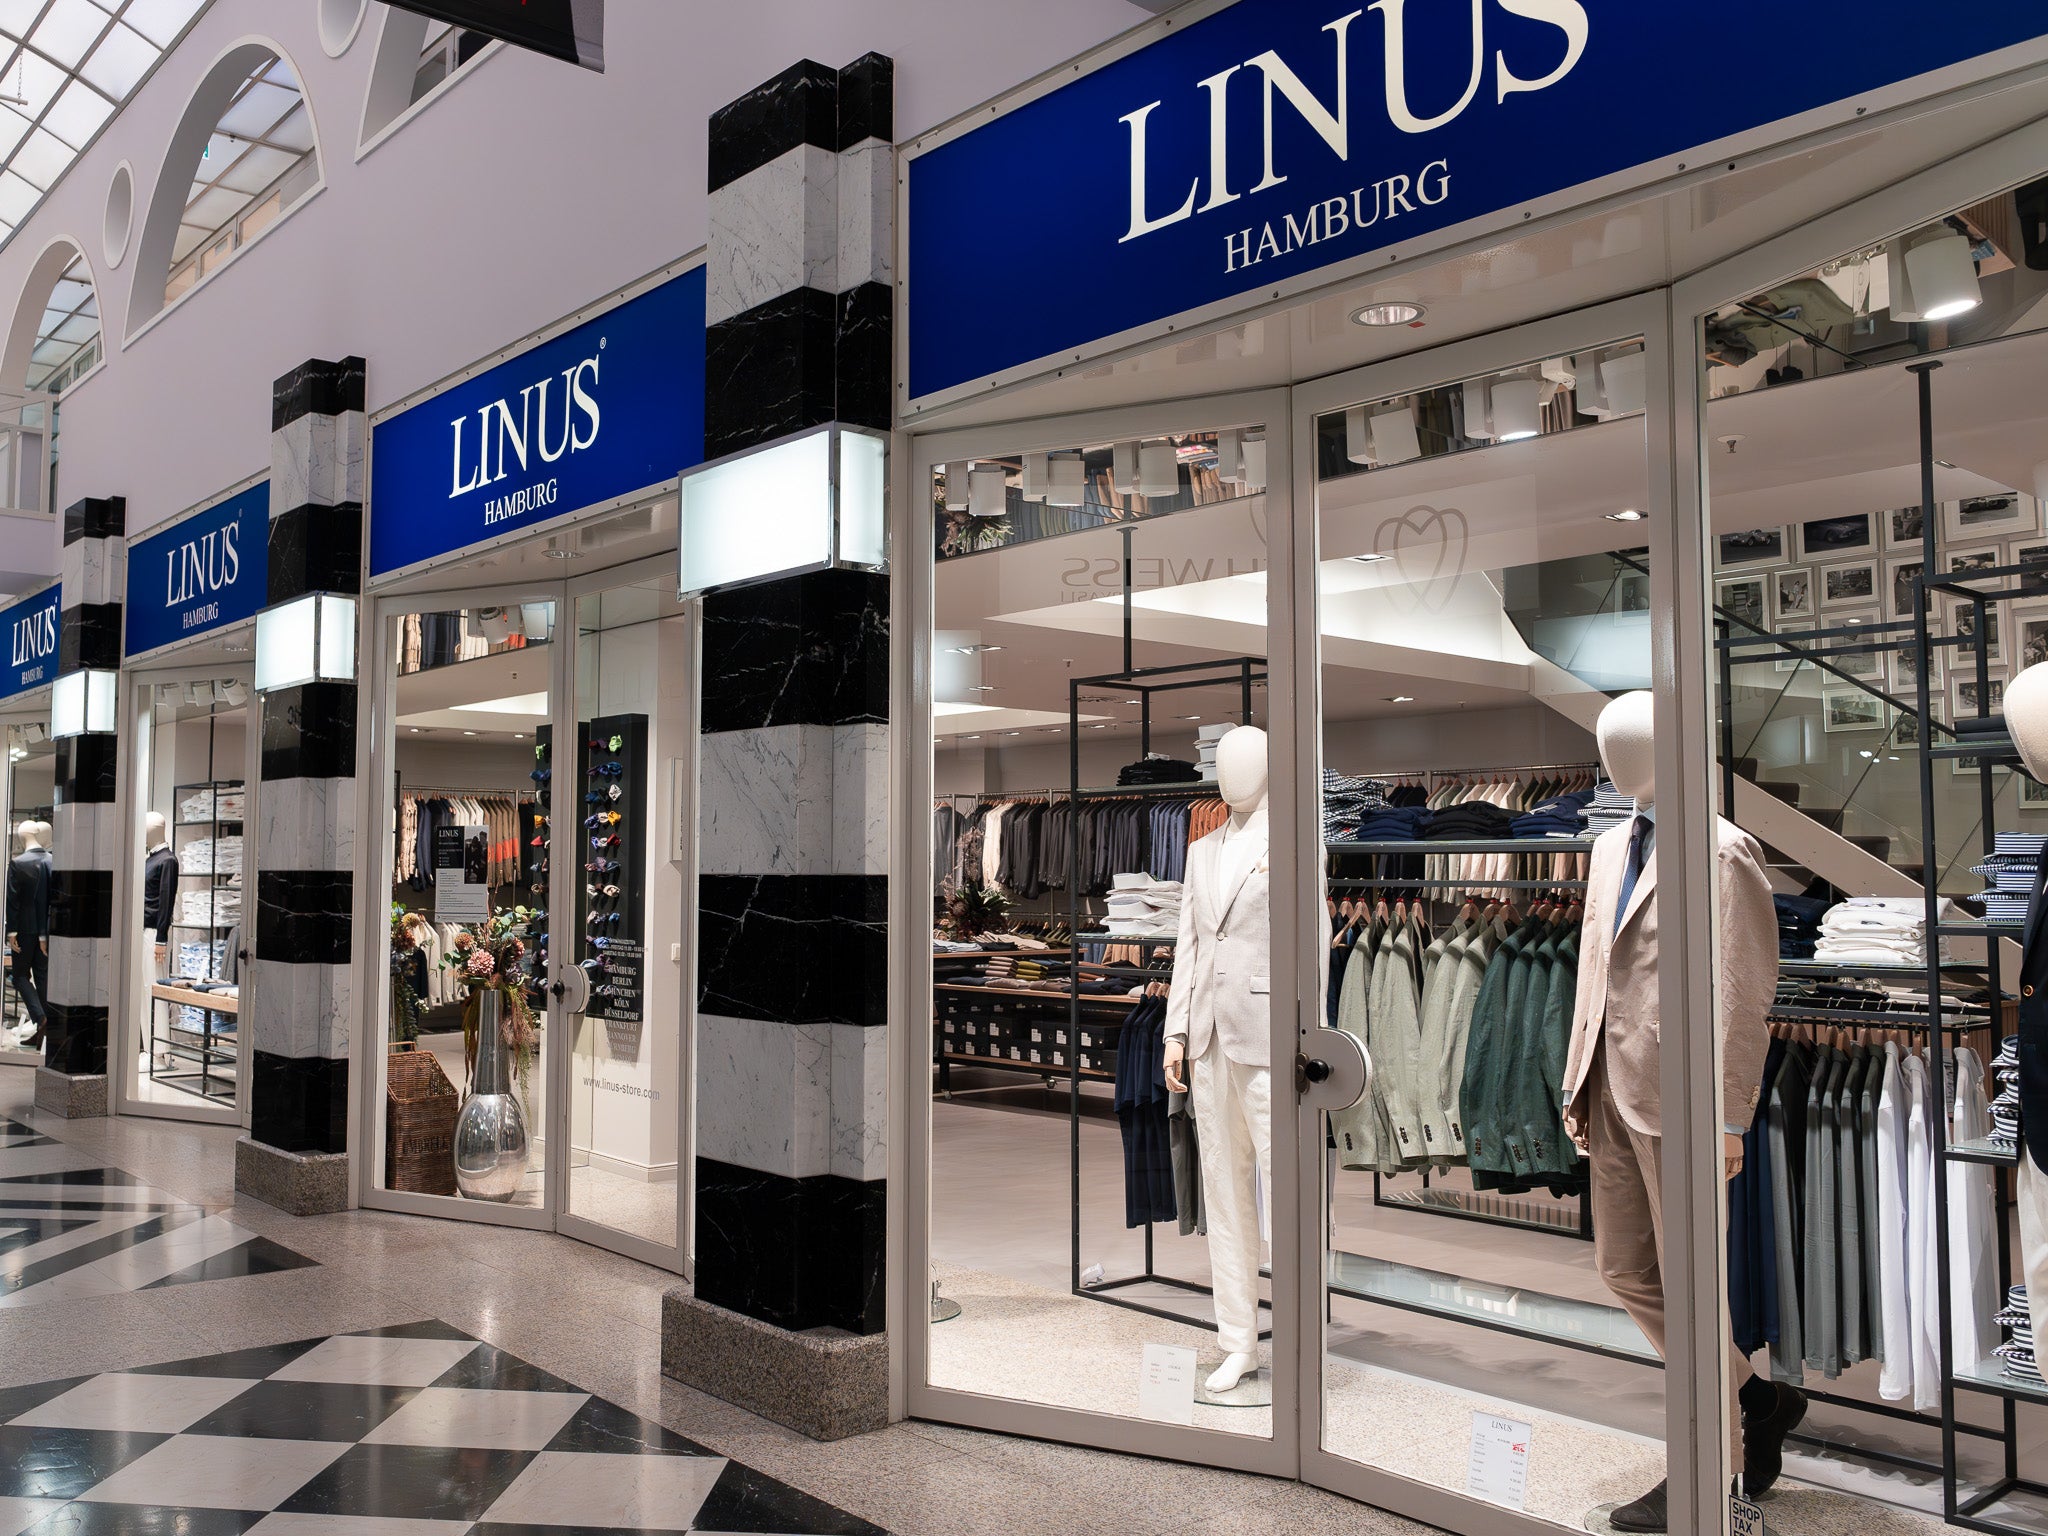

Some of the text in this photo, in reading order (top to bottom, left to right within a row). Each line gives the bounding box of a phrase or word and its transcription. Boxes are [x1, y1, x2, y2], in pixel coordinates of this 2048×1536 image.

[1118, 0, 1589, 245] LINUS
[1223, 158, 1452, 274] HAMBURG
[449, 353, 600, 498] LINUS
[484, 477, 558, 526] HAMBURG
[165, 519, 239, 607] LINUS
[182, 601, 219, 630] HAMBURG
[11, 603, 56, 668] LINUS
[438, 829, 459, 838] LINUS
[612, 976, 632, 986] BERLIN
[604, 1007, 639, 1021] DÜSSELDORF
[613, 997, 630, 1008] KÖLN
[582, 1076, 660, 1101] www.linus-store.com
[1491, 1420, 1513, 1432] LINUS
[1732, 1501, 1760, 1522] SHOP
[1732, 1515, 1753, 1535] TAX
